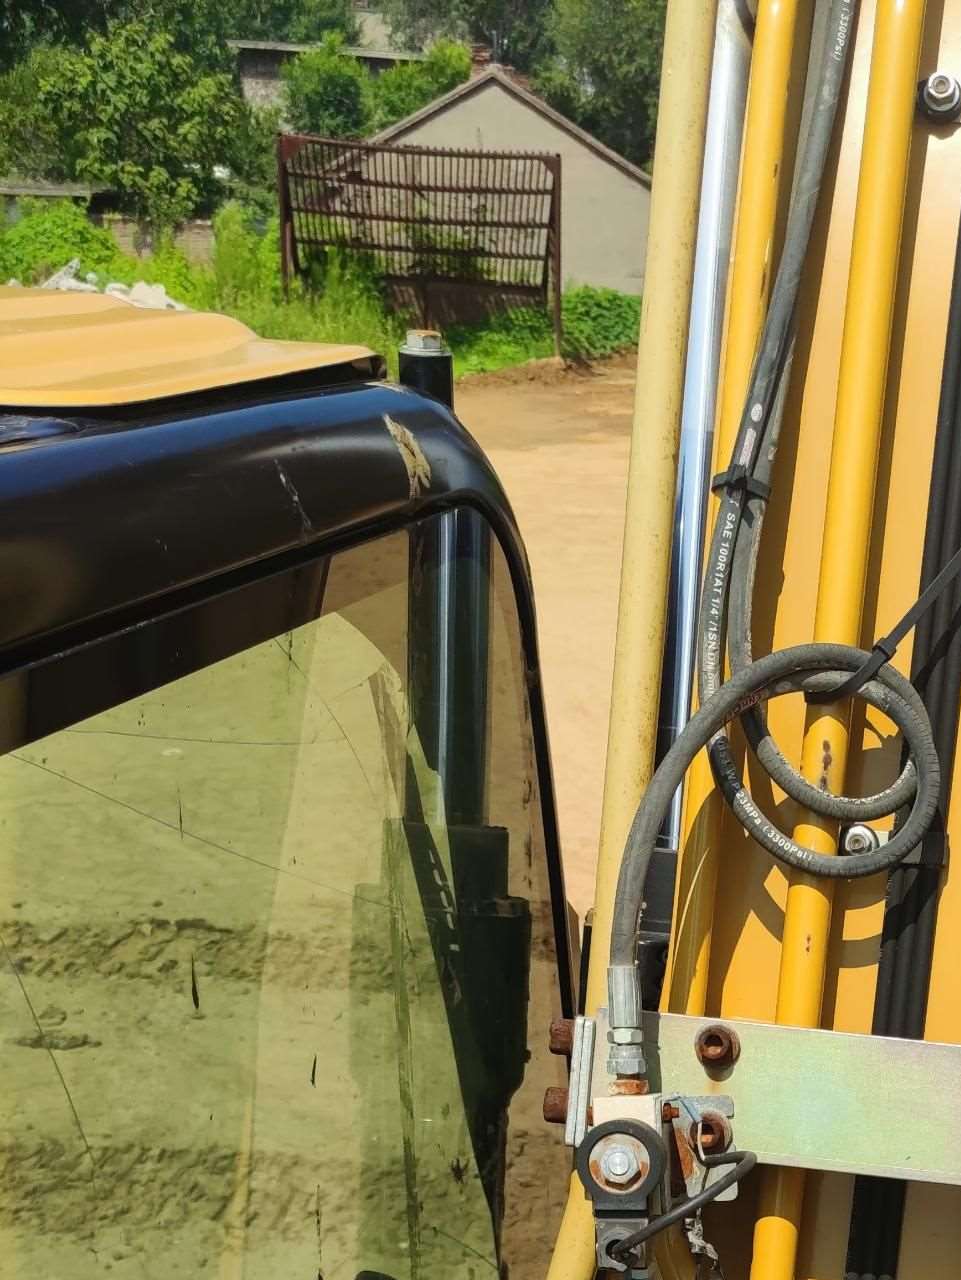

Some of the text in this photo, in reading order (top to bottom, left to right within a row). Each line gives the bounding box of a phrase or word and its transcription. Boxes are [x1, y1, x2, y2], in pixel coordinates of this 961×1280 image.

[721, 512, 736, 539] SAE
[712, 541, 730, 595] 100R1AT
[735, 791, 762, 825] 23MPa
